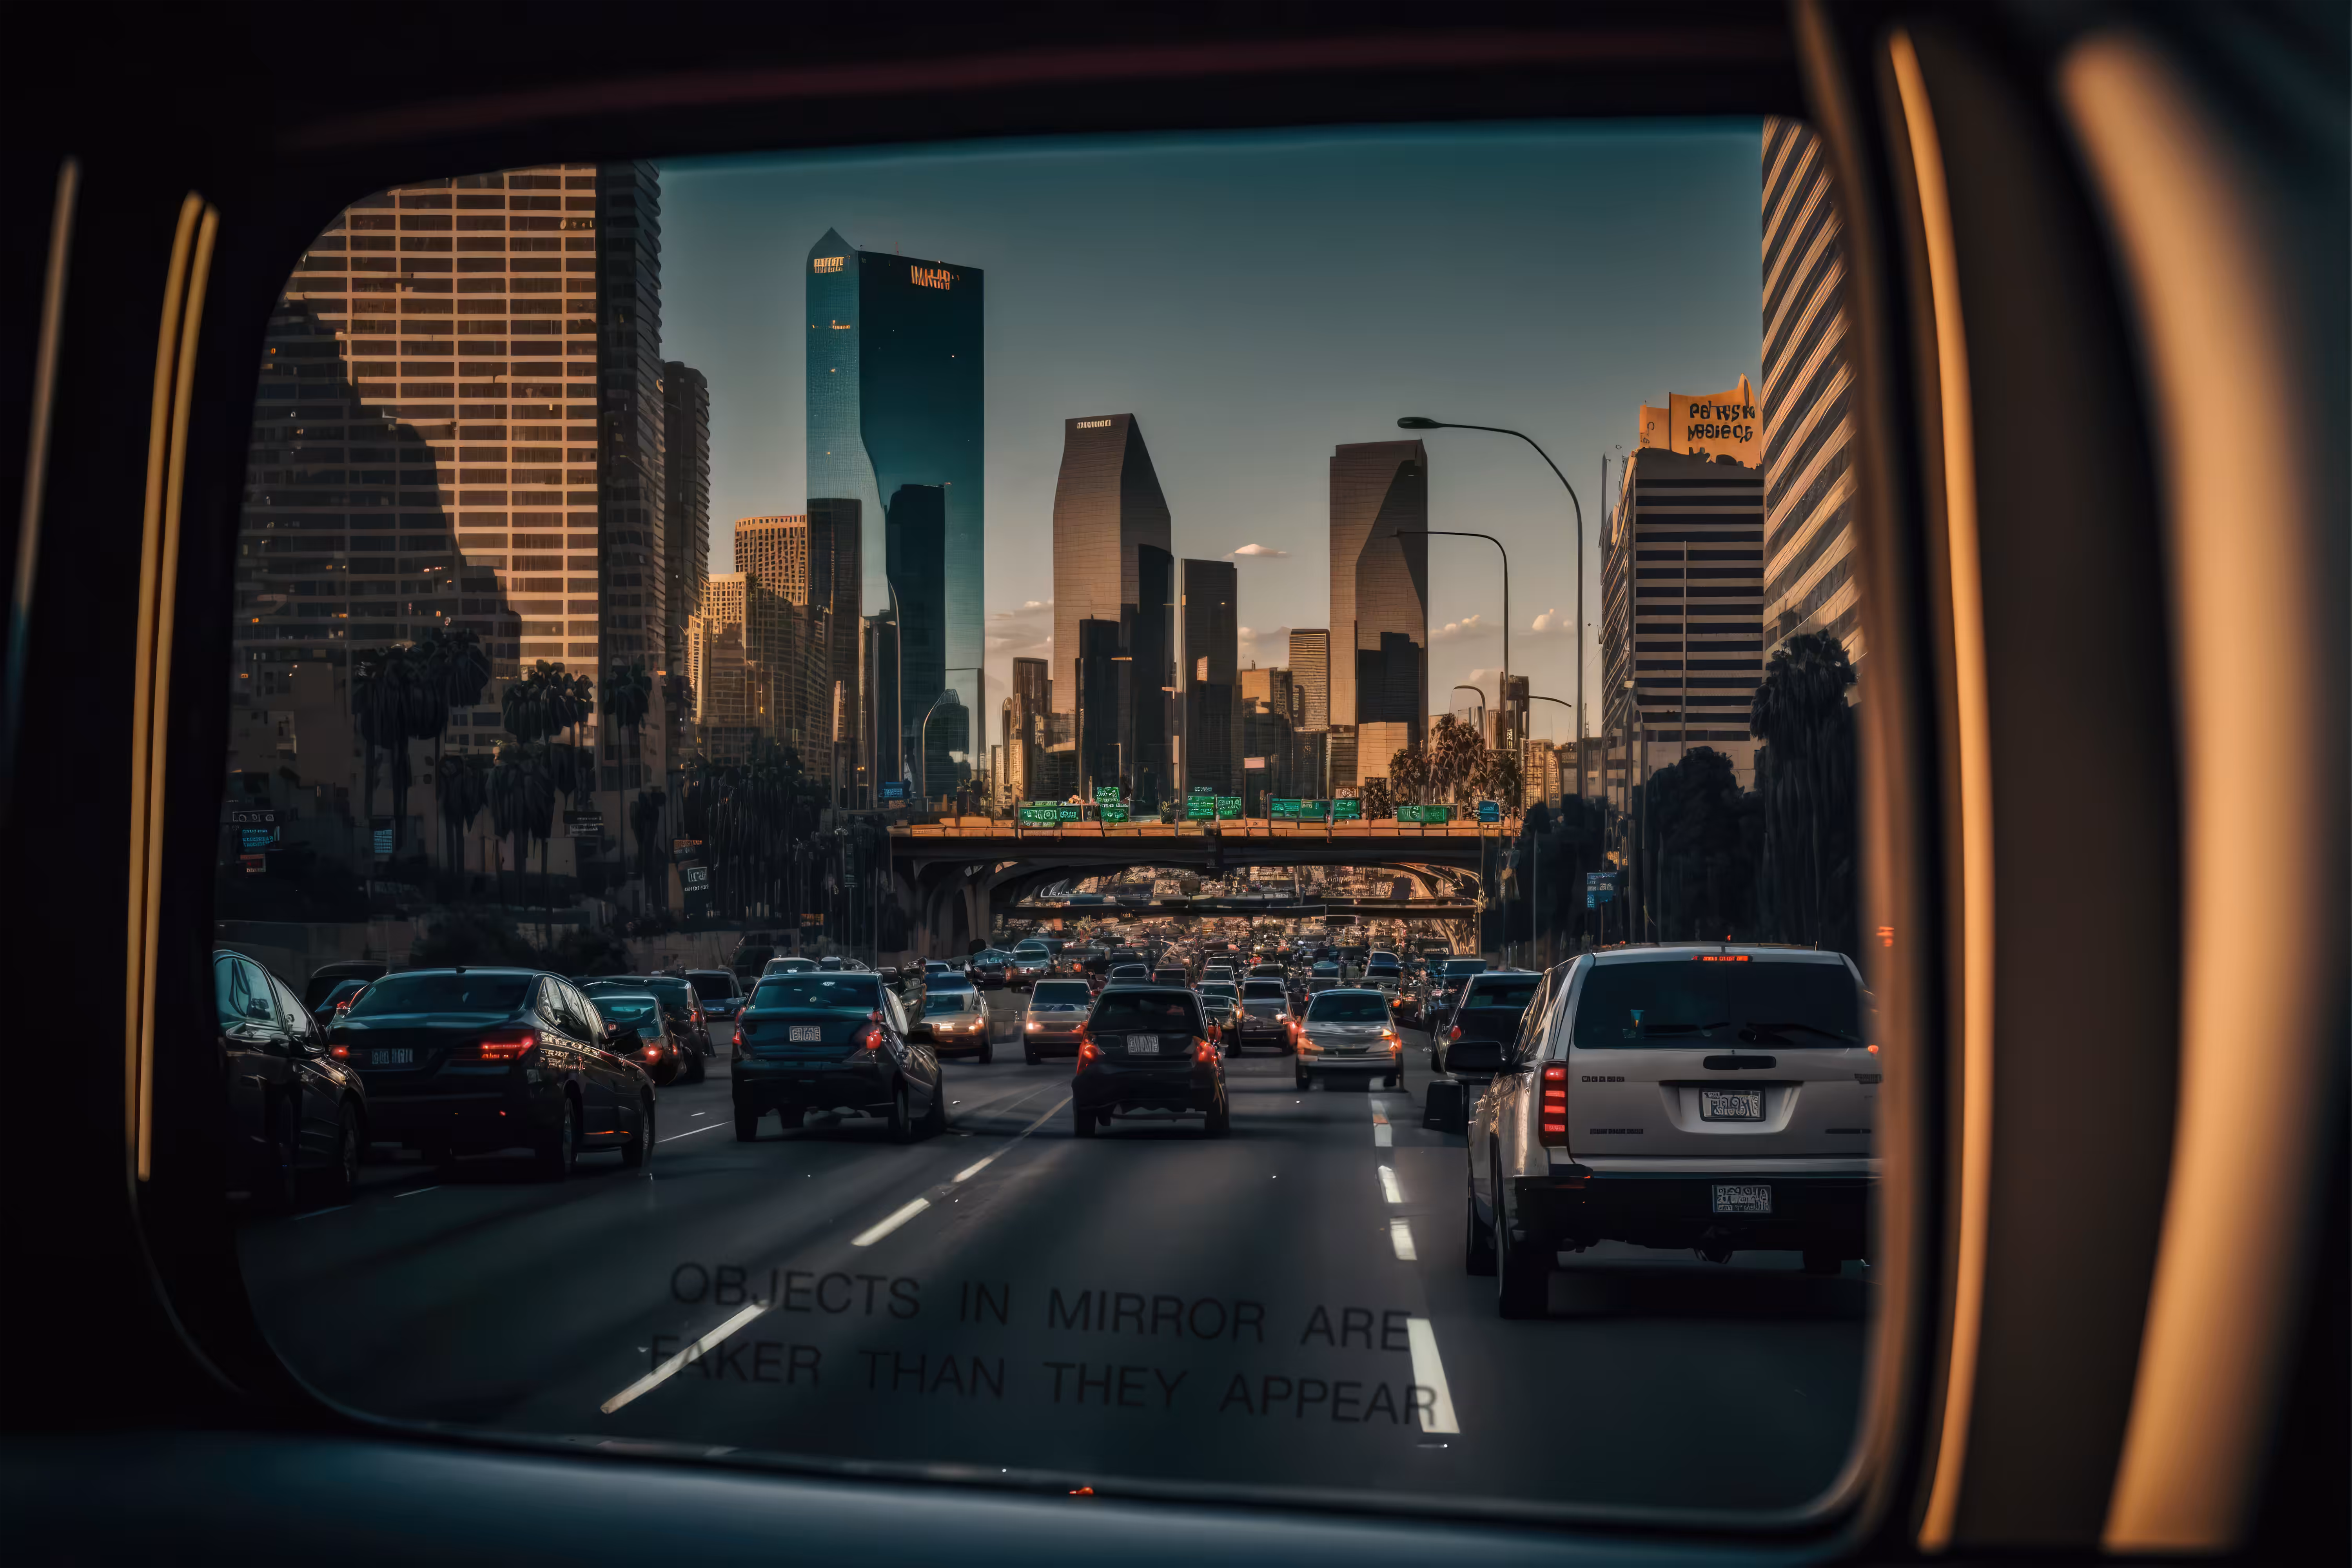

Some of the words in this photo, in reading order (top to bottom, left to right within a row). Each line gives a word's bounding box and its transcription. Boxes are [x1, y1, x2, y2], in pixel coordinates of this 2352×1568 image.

[670, 1262, 921, 1319] OBJECTS
[959, 1280, 1009, 1326] IN
[1048, 1287, 1265, 1343] MIRROR
[1300, 1305, 1412, 1352] ARE
[650, 1334, 822, 1387] FAKER
[858, 1350, 1004, 1399] THAN
[1042, 1361, 1188, 1408] THEY
[1219, 1374, 1439, 1426] APPEAR
